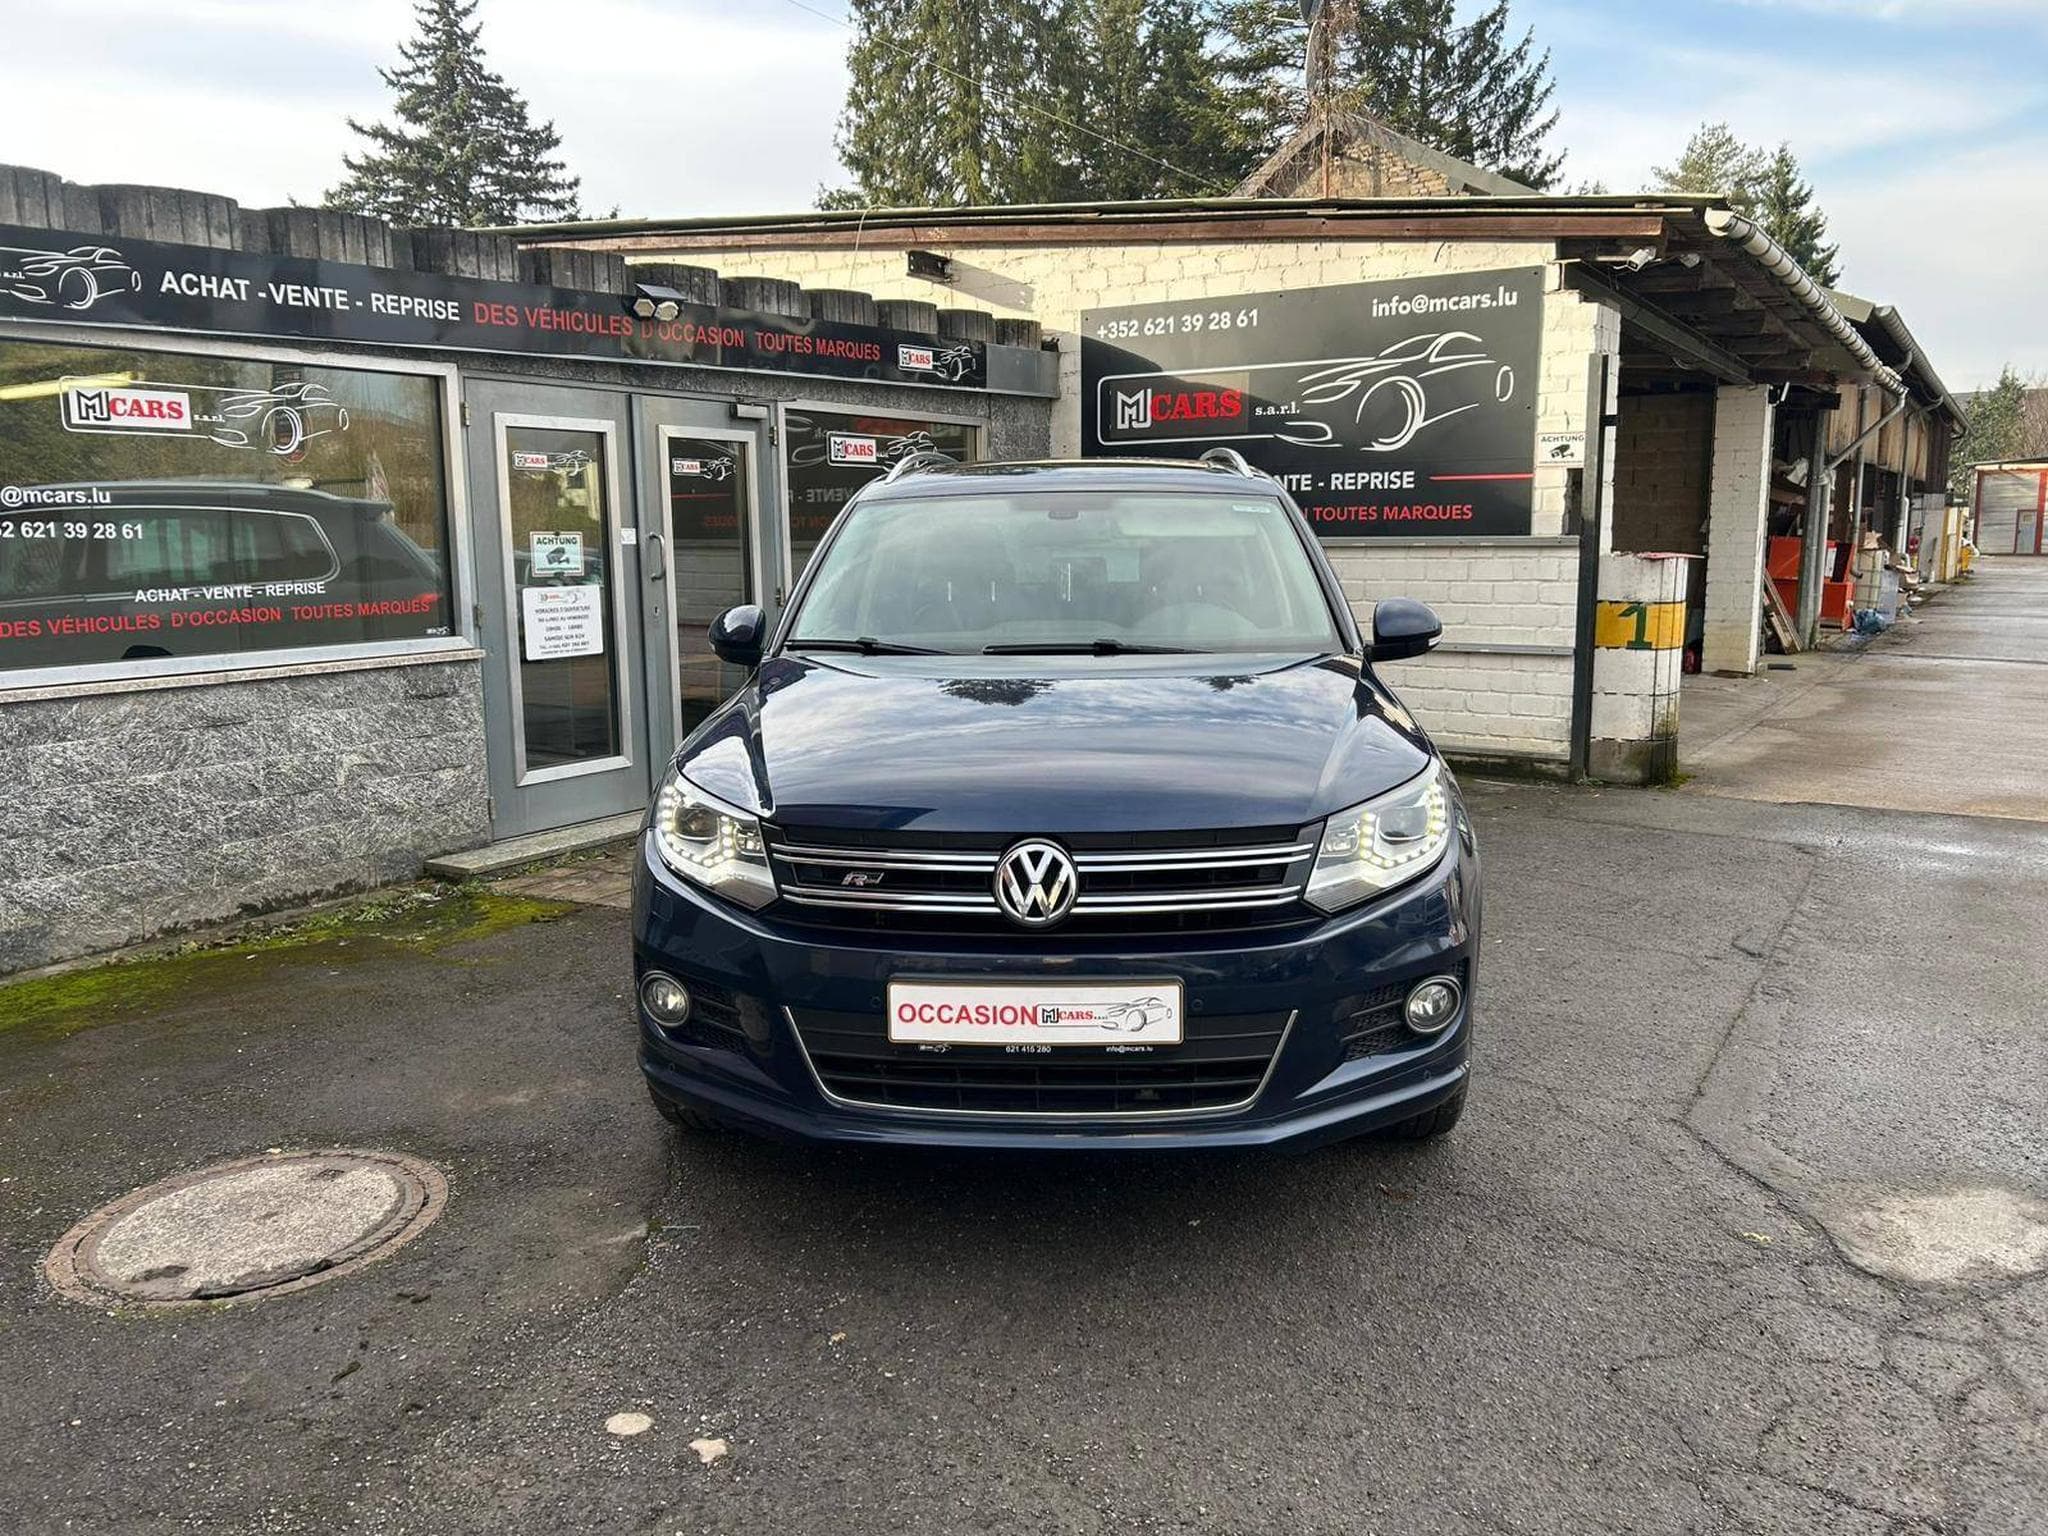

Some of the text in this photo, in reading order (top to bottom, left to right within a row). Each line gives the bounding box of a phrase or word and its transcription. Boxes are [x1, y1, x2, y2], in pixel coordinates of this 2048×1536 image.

[1372, 285, 1518, 318] info@mcars.lu
[160, 270, 250, 301] ACHAT
[370, 292, 461, 322] REPRISE
[473, 302, 519, 327] DES
[524, 300, 633, 337] VÉHICULES
[640, 320, 745, 348] DOCCASION
[755, 331, 812, 355] TOUTES
[815, 338, 881, 362] MARQUES
[1097, 308, 1259, 340] +352 621 39 28 61
[109, 397, 184, 420] CARS
[193, 413, 226, 423] s.a.r.l.
[1151, 387, 1242, 422] CARS
[1254, 401, 1301, 416] s.a.r.l.
[1541, 434, 1585, 442] ACHTUNG
[845, 443, 874, 457] CARS
[1274, 473, 1312, 491] NTE
[1330, 470, 1415, 491] REPRISE
[0, 485, 112, 508] @mcars.lu
[1313, 506, 1378, 522] TOUTES
[1383, 504, 1473, 521] MARQUES
[20, 521, 56, 538] 621
[64, 522, 87, 539] 39
[93, 523, 117, 539] 28
[122, 523, 143, 540] 61
[536, 536, 578, 545] ACHTUNG
[135, 588, 189, 603] ACHAT
[202, 585, 252, 600] VENTE
[265, 582, 326, 598] REPRISE
[0, 598, 430, 639] DES VÉHICULES D'OCCASION TOUTES MARQUES
[1618, 603, 1653, 650] 1
[899, 1003, 1037, 1025] OCCASION
[1059, 1010, 1094, 1021] CARS
